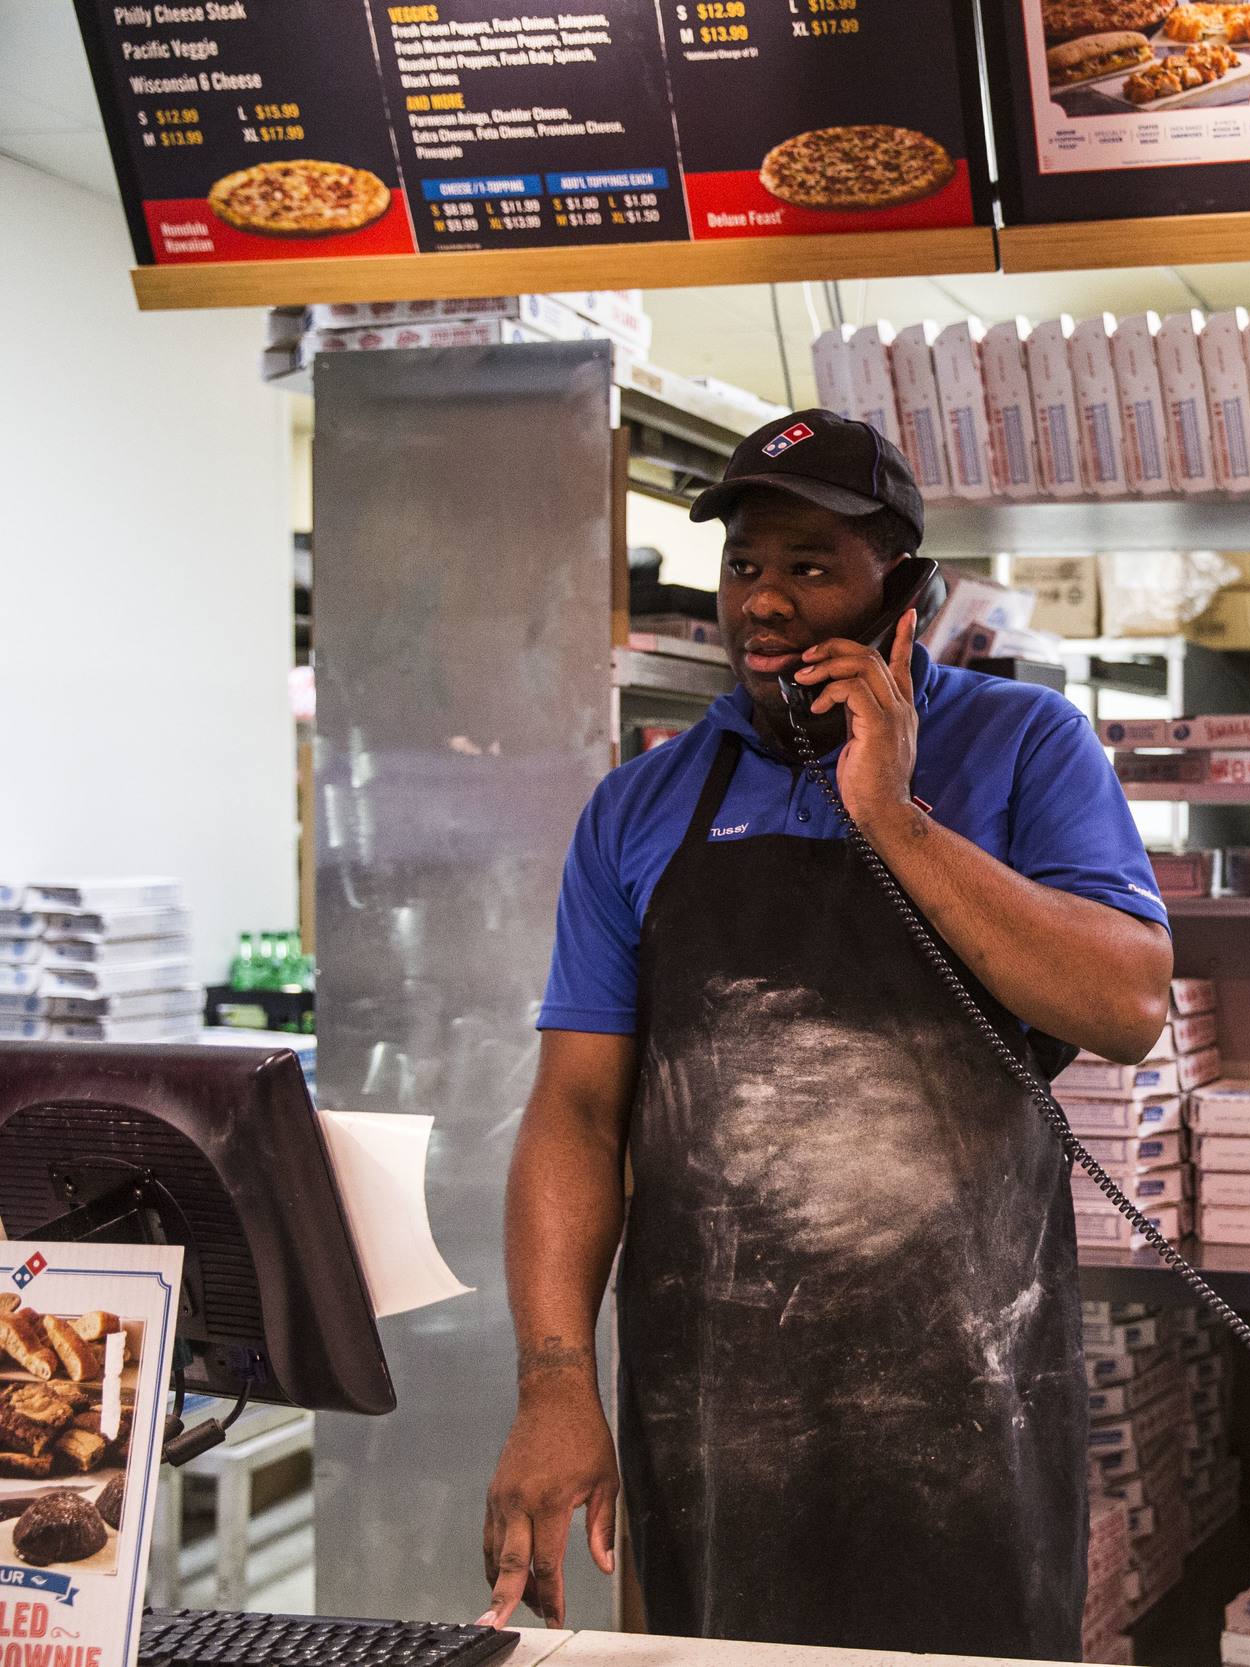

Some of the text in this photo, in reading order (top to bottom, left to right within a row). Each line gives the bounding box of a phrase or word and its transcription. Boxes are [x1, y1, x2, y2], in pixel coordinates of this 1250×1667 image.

[114, 1, 247, 27] Philly Cheese Steak
[676, 1, 746, 21] S $12.99
[679, 24, 749, 44] M $13.99
[792, 18, 860, 37] XL $17.99
[122, 38, 218, 60] Pacific Veggie
[129, 72, 262, 94] Wisconsin 6 Cheese
[138, 109, 199, 125] S $12.99
[237, 103, 300, 121] L $15.99
[143, 131, 203, 147] M $13.99
[242, 125, 304, 143] XL $17.99
[707, 212, 747, 228] Deluxe
[710, 822, 749, 837] Tussy
